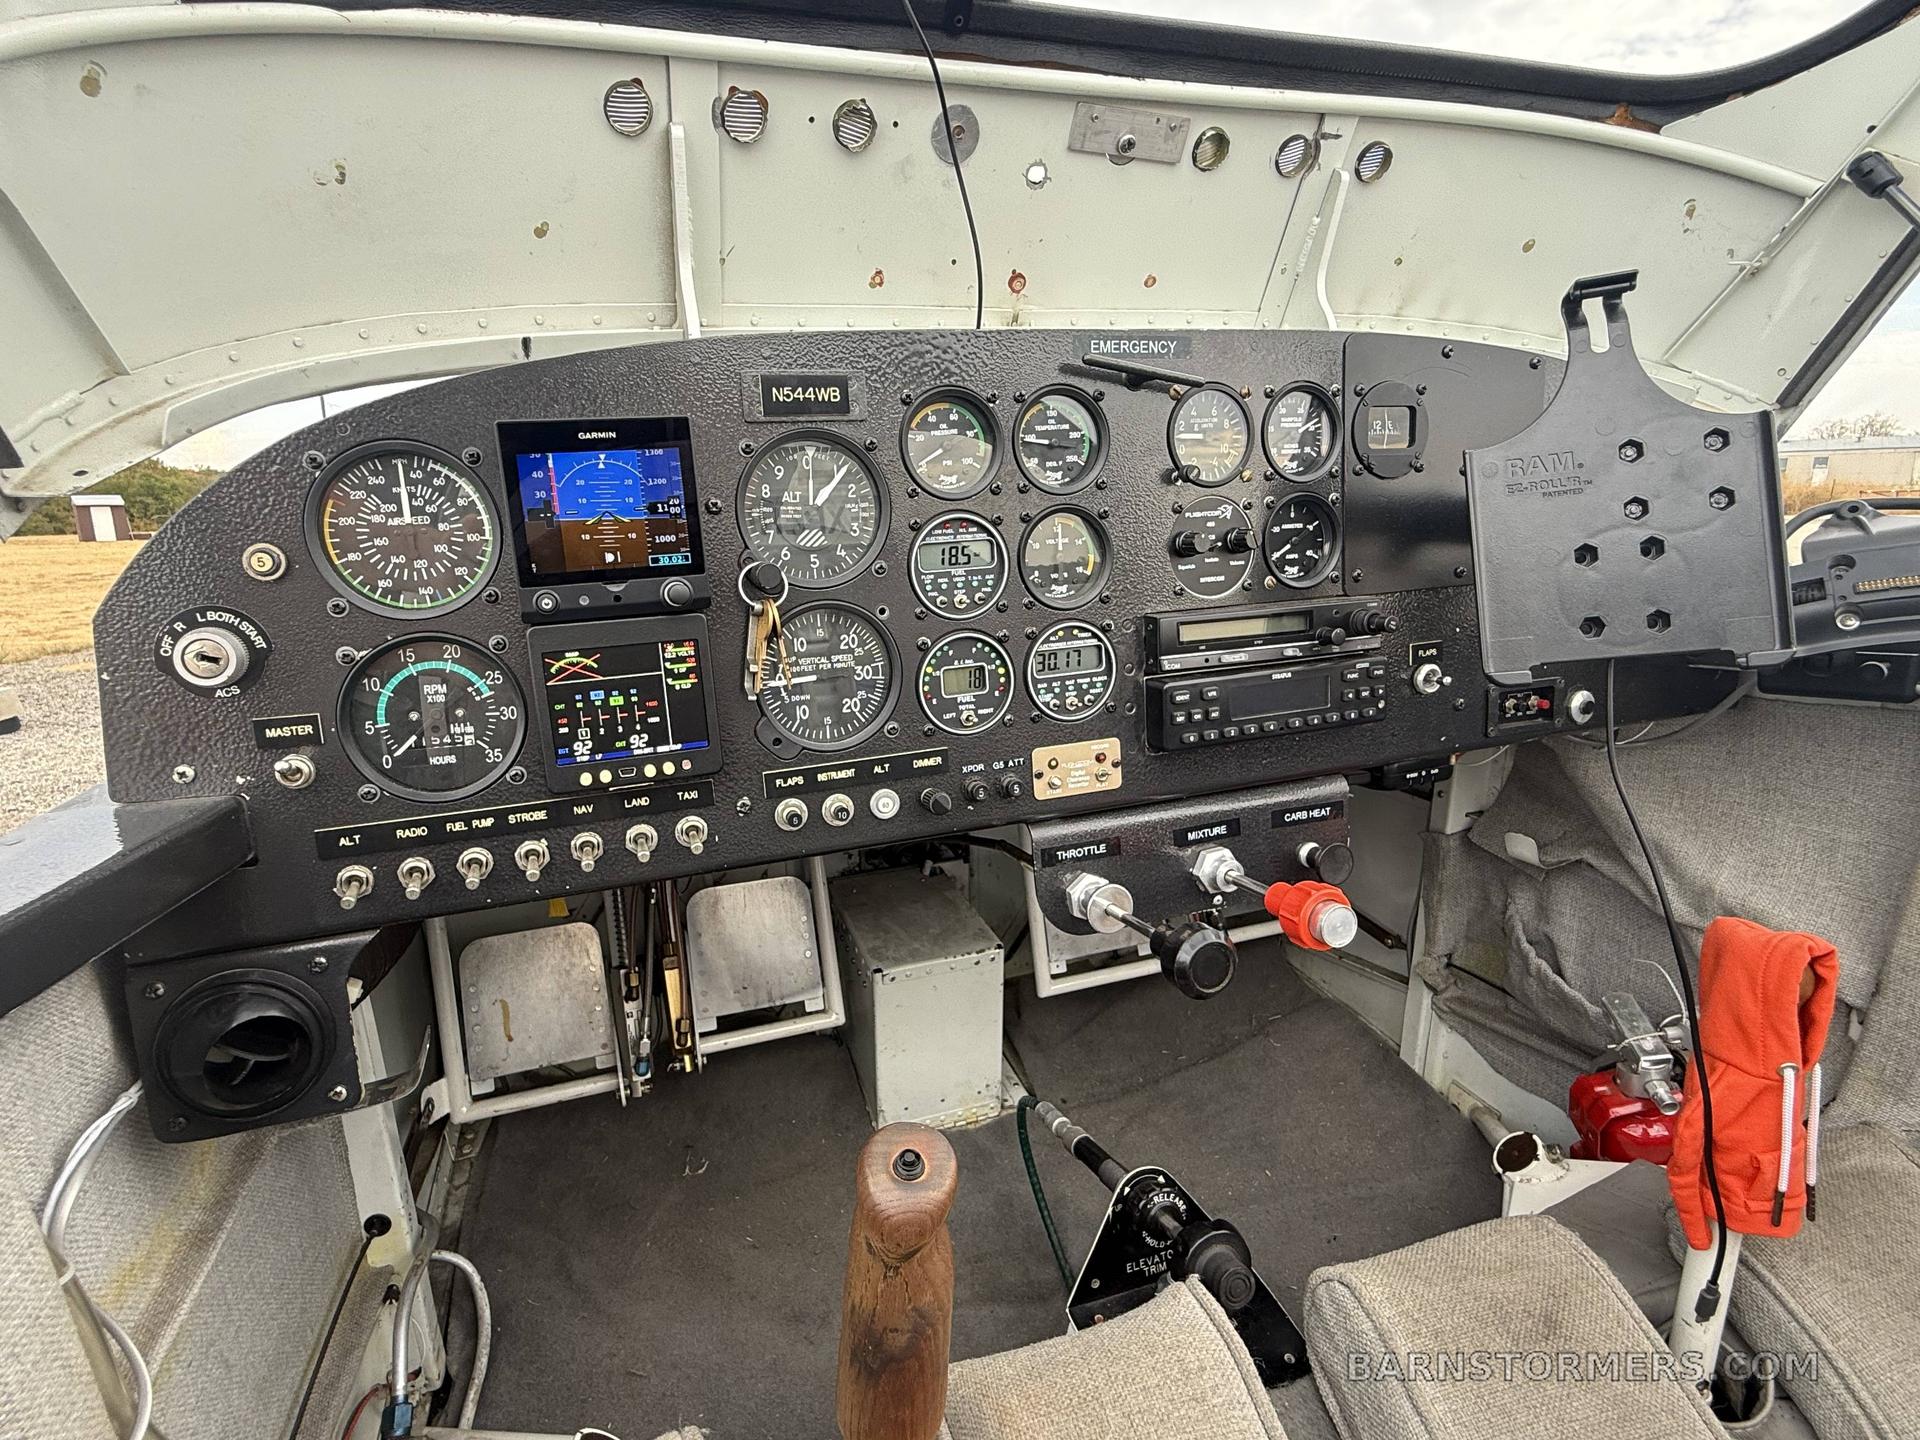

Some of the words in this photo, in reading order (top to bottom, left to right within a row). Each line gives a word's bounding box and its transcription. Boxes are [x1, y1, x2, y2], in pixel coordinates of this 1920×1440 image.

[1091, 339, 1177, 355] EMERGENCY
[772, 387, 840, 402] N544WB
[1191, 408, 1197, 416] 4
[1212, 407, 1217, 415] 6
[1179, 422, 1184, 431] 2
[1223, 420, 1230, 429] 8
[1373, 421, 1382, 429] 12
[1389, 421, 1393, 429] E
[578, 432, 616, 440] GARMIN
[1179, 443, 1185, 454] 0
[1220, 444, 1228, 452] 10
[1506, 451, 1575, 477] RAM
[775, 465, 784, 479] 9
[762, 484, 770, 497] 8
[782, 492, 801, 502] ALT
[848, 484, 856, 497] 2
[1543, 488, 1583, 497] PATENTED
[380, 504, 397, 512] 200
[412, 498, 424, 506] 40
[457, 498, 468, 506] 80
[851, 523, 859, 536] 3
[766, 530, 774, 544] 7
[781, 547, 790, 560] 6
[837, 544, 846, 556] 4
[941, 546, 971, 566] 18.5
[257, 557, 265, 567] 5
[391, 555, 405, 563] 140
[810, 555, 819, 568] 5
[455, 567, 468, 575] 120
[196, 613, 206, 623] L
[207, 611, 240, 627] BOTH
[173, 621, 186, 632] R
[239, 621, 267, 650] START
[840, 634, 858, 649] 20
[160, 636, 174, 656] OFF
[794, 637, 807, 652] 10
[398, 649, 415, 662] 15
[443, 645, 460, 658] 20
[831, 654, 853, 662] SPEED
[855, 648, 863, 656] 25
[1419, 648, 1437, 657] FLAPS
[1037, 650, 1081, 671] 30.17
[485, 671, 502, 684] 25
[854, 665, 872, 680] 30
[969, 669, 980, 688] 18
[362, 678, 380, 691] 10
[424, 684, 447, 694] RPM
[215, 686, 240, 698] ACS
[842, 698, 860, 712] 20
[500, 706, 517, 720] 30
[797, 705, 809, 719] 10
[265, 724, 312, 737] MASTER
[365, 721, 374, 734] 5
[630, 734, 648, 748] 92
[574, 741, 592, 755] 92
[383, 755, 392, 768] 0
[430, 755, 456, 764] HOURS
[485, 749, 502, 762] 35
[913, 756, 942, 768] DIMMER
[874, 764, 889, 774] ALT
[962, 764, 984, 774] XPDR
[993, 761, 1004, 769] G5
[1008, 757, 1024, 767] ATT
[776, 775, 804, 787] FLAPS
[817, 769, 856, 782] INSTRUMENT
[677, 791, 698, 801] TAXI
[979, 789, 984, 797] 5
[1014, 785, 1019, 794] 5
[625, 797, 649, 808] LAND
[574, 804, 593, 815] NAV
[838, 810, 847, 819] 10
[1284, 810, 1308, 822] CARB
[1309, 807, 1330, 819] HEAT
[508, 811, 547, 824] STROBE
[446, 821, 467, 832] FUEL
[472, 817, 494, 829] PUMP
[396, 827, 427, 839] RADIO
[1188, 825, 1227, 841] MIXTURE
[340, 835, 360, 847] ALT
[1056, 844, 1106, 860] THROTTLE
[1154, 1193, 1186, 1213] RELEASE
[1146, 1237, 1165, 1248] HOLD
[1127, 1250, 1173, 1273] ELEVATO
[1143, 1264, 1167, 1277] TRIM
